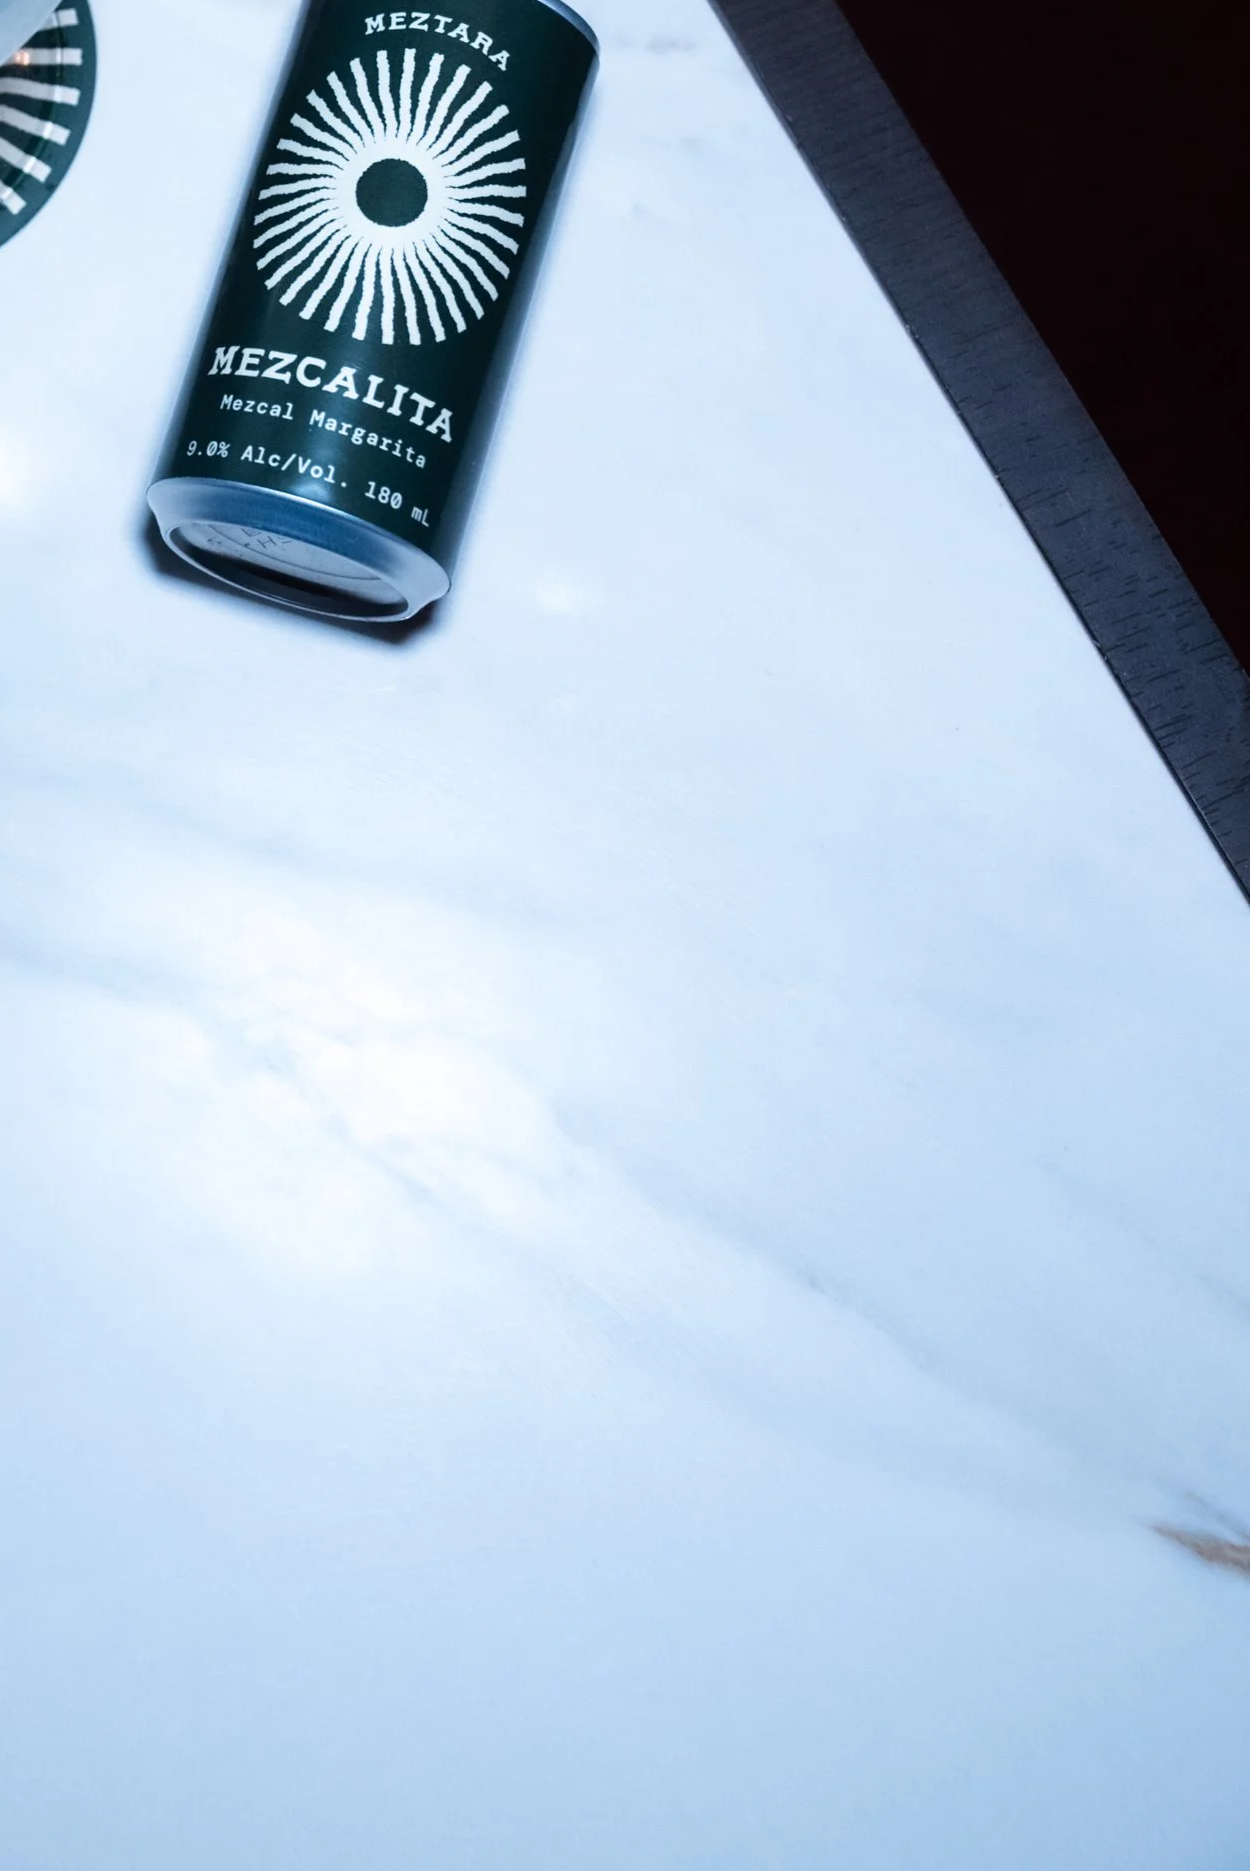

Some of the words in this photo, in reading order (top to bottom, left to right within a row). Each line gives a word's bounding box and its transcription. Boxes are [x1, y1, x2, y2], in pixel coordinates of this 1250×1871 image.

[364, 11, 511, 72] MEZTARA
[207, 344, 453, 443] MEZCALITA
[219, 393, 295, 421] Mezcal
[308, 409, 427, 469] Margarita
[186, 440, 230, 459] 9.0%
[240, 445, 349, 488] Alc/Vol.
[364, 481, 404, 510] 180
[411, 505, 431, 528] mL
